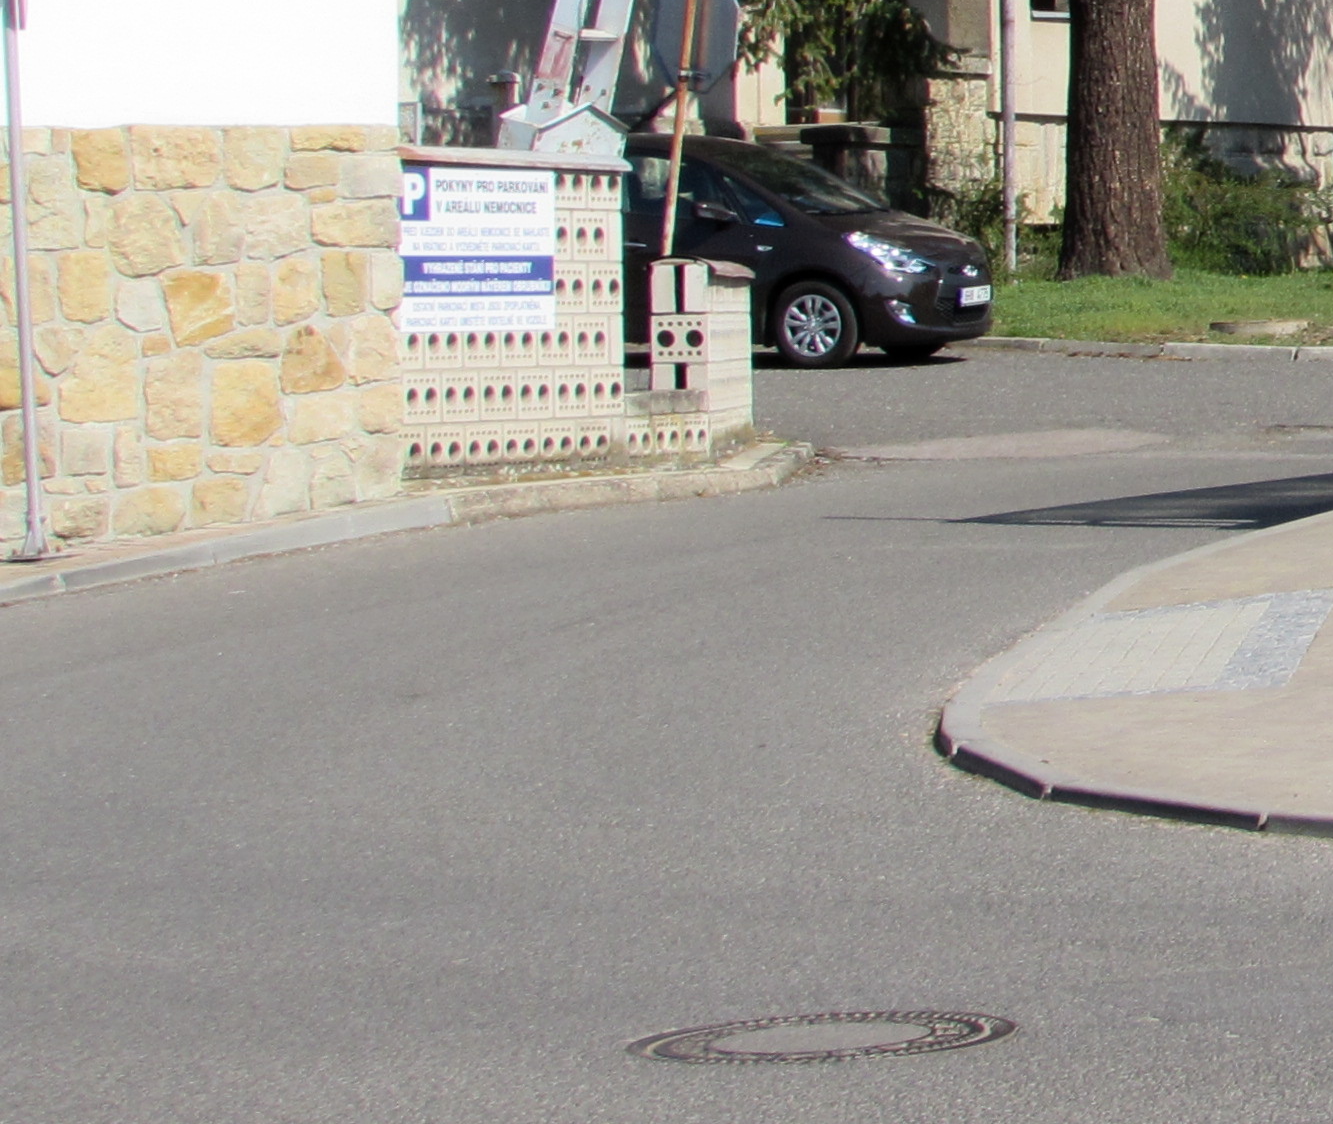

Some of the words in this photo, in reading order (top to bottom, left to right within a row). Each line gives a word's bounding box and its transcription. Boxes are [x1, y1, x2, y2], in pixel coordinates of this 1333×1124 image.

[435, 179, 474, 193] POKYNY
[476, 179, 494, 193] PRO
[403, 173, 425, 215] P
[436, 200, 443, 214] V
[483, 200, 537, 214] NEMOCNICE
